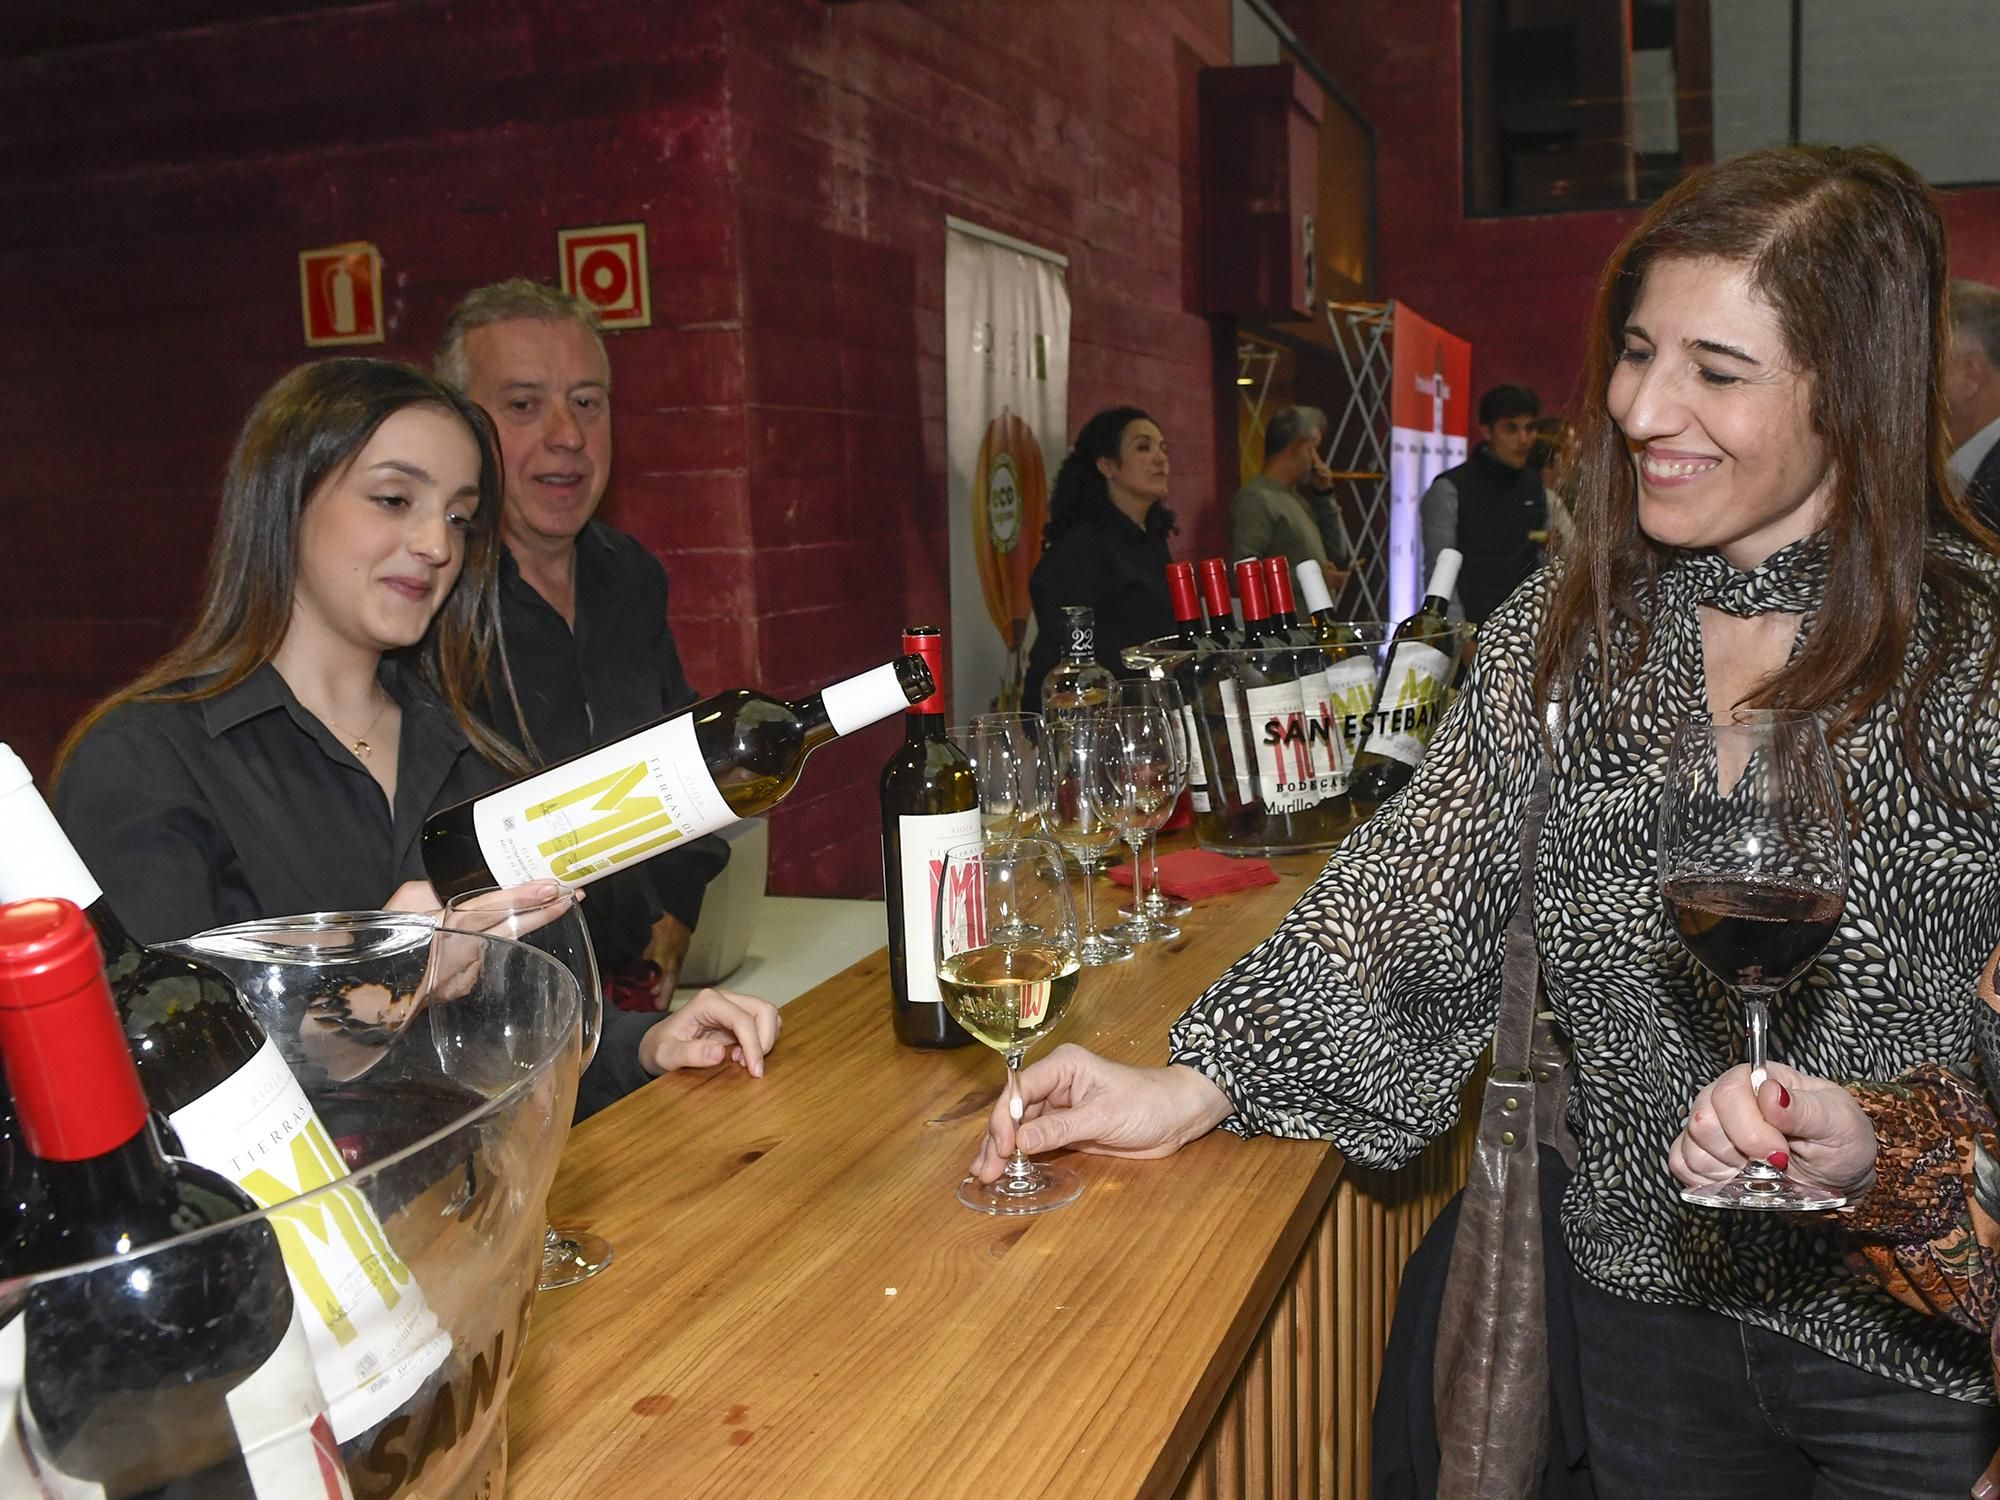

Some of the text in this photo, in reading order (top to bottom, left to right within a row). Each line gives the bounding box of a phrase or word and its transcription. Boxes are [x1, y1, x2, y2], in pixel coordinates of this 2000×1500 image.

[1071, 628, 1094, 651] 22
[1263, 718, 1330, 745] SAN
[1344, 701, 1440, 739] ESTEBAN
[649, 757, 682, 820] TIERRAS
[682, 821, 697, 835] DE
[1276, 777, 1348, 793] BODEGAS
[231, 1102, 307, 1173] TIERRAS
